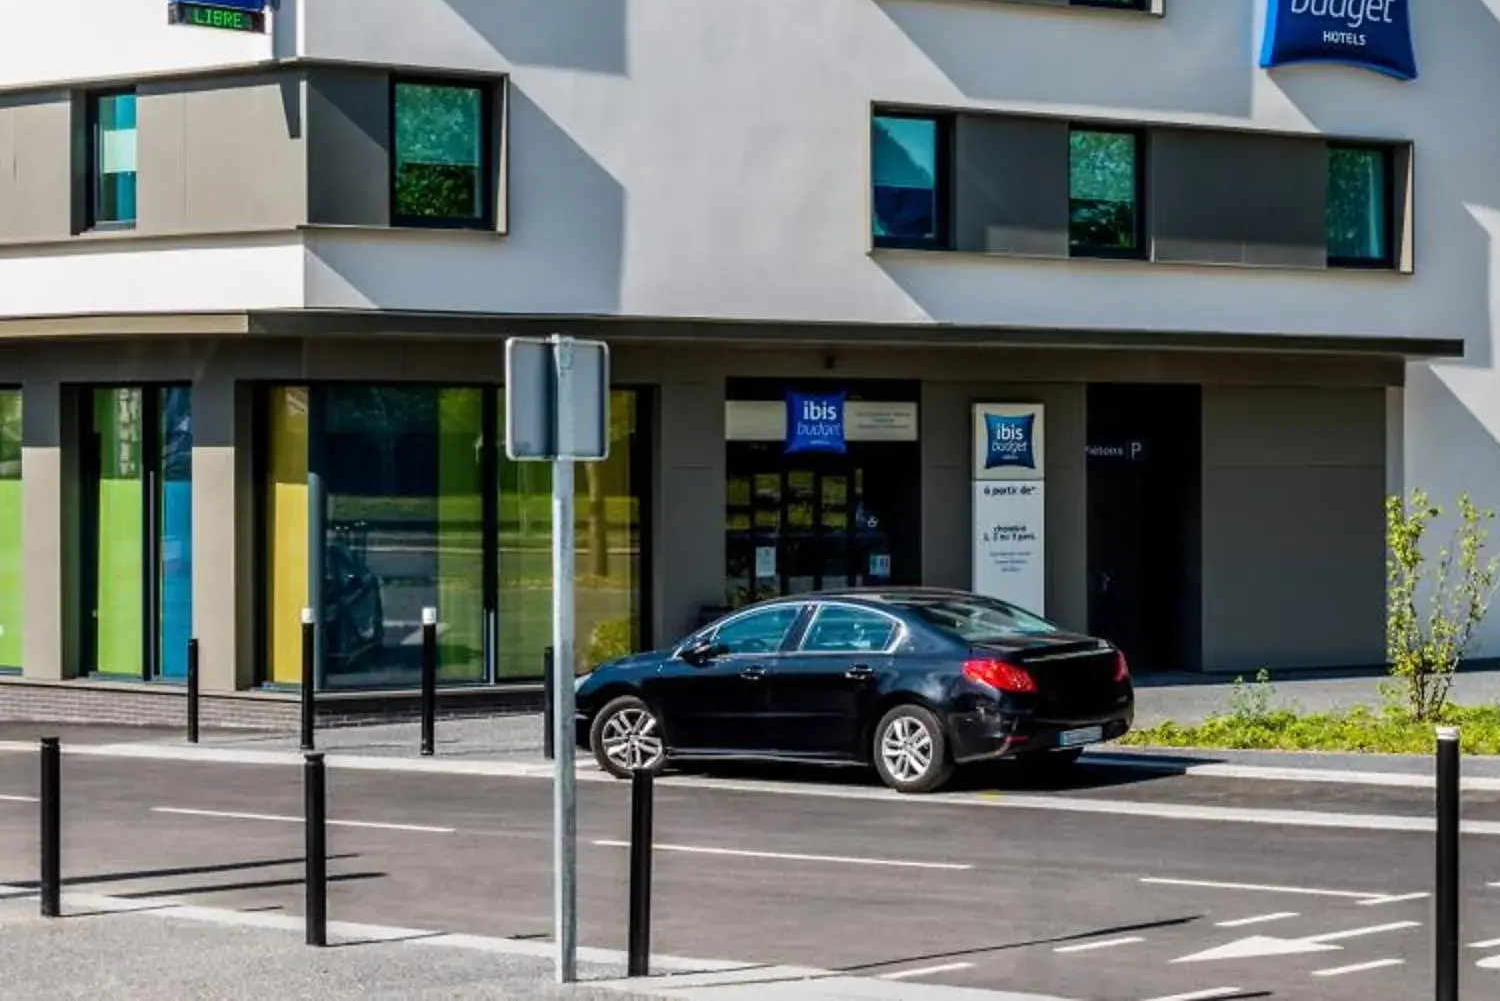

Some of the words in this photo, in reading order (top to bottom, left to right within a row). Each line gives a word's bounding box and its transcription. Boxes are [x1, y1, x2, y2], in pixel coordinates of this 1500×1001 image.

[194, 8, 244, 28] LIBRE
[1322, 30, 1367, 46] HOTELS
[803, 400, 837, 421] ibis
[796, 422, 841, 437] budget
[996, 422, 1023, 440] ibis
